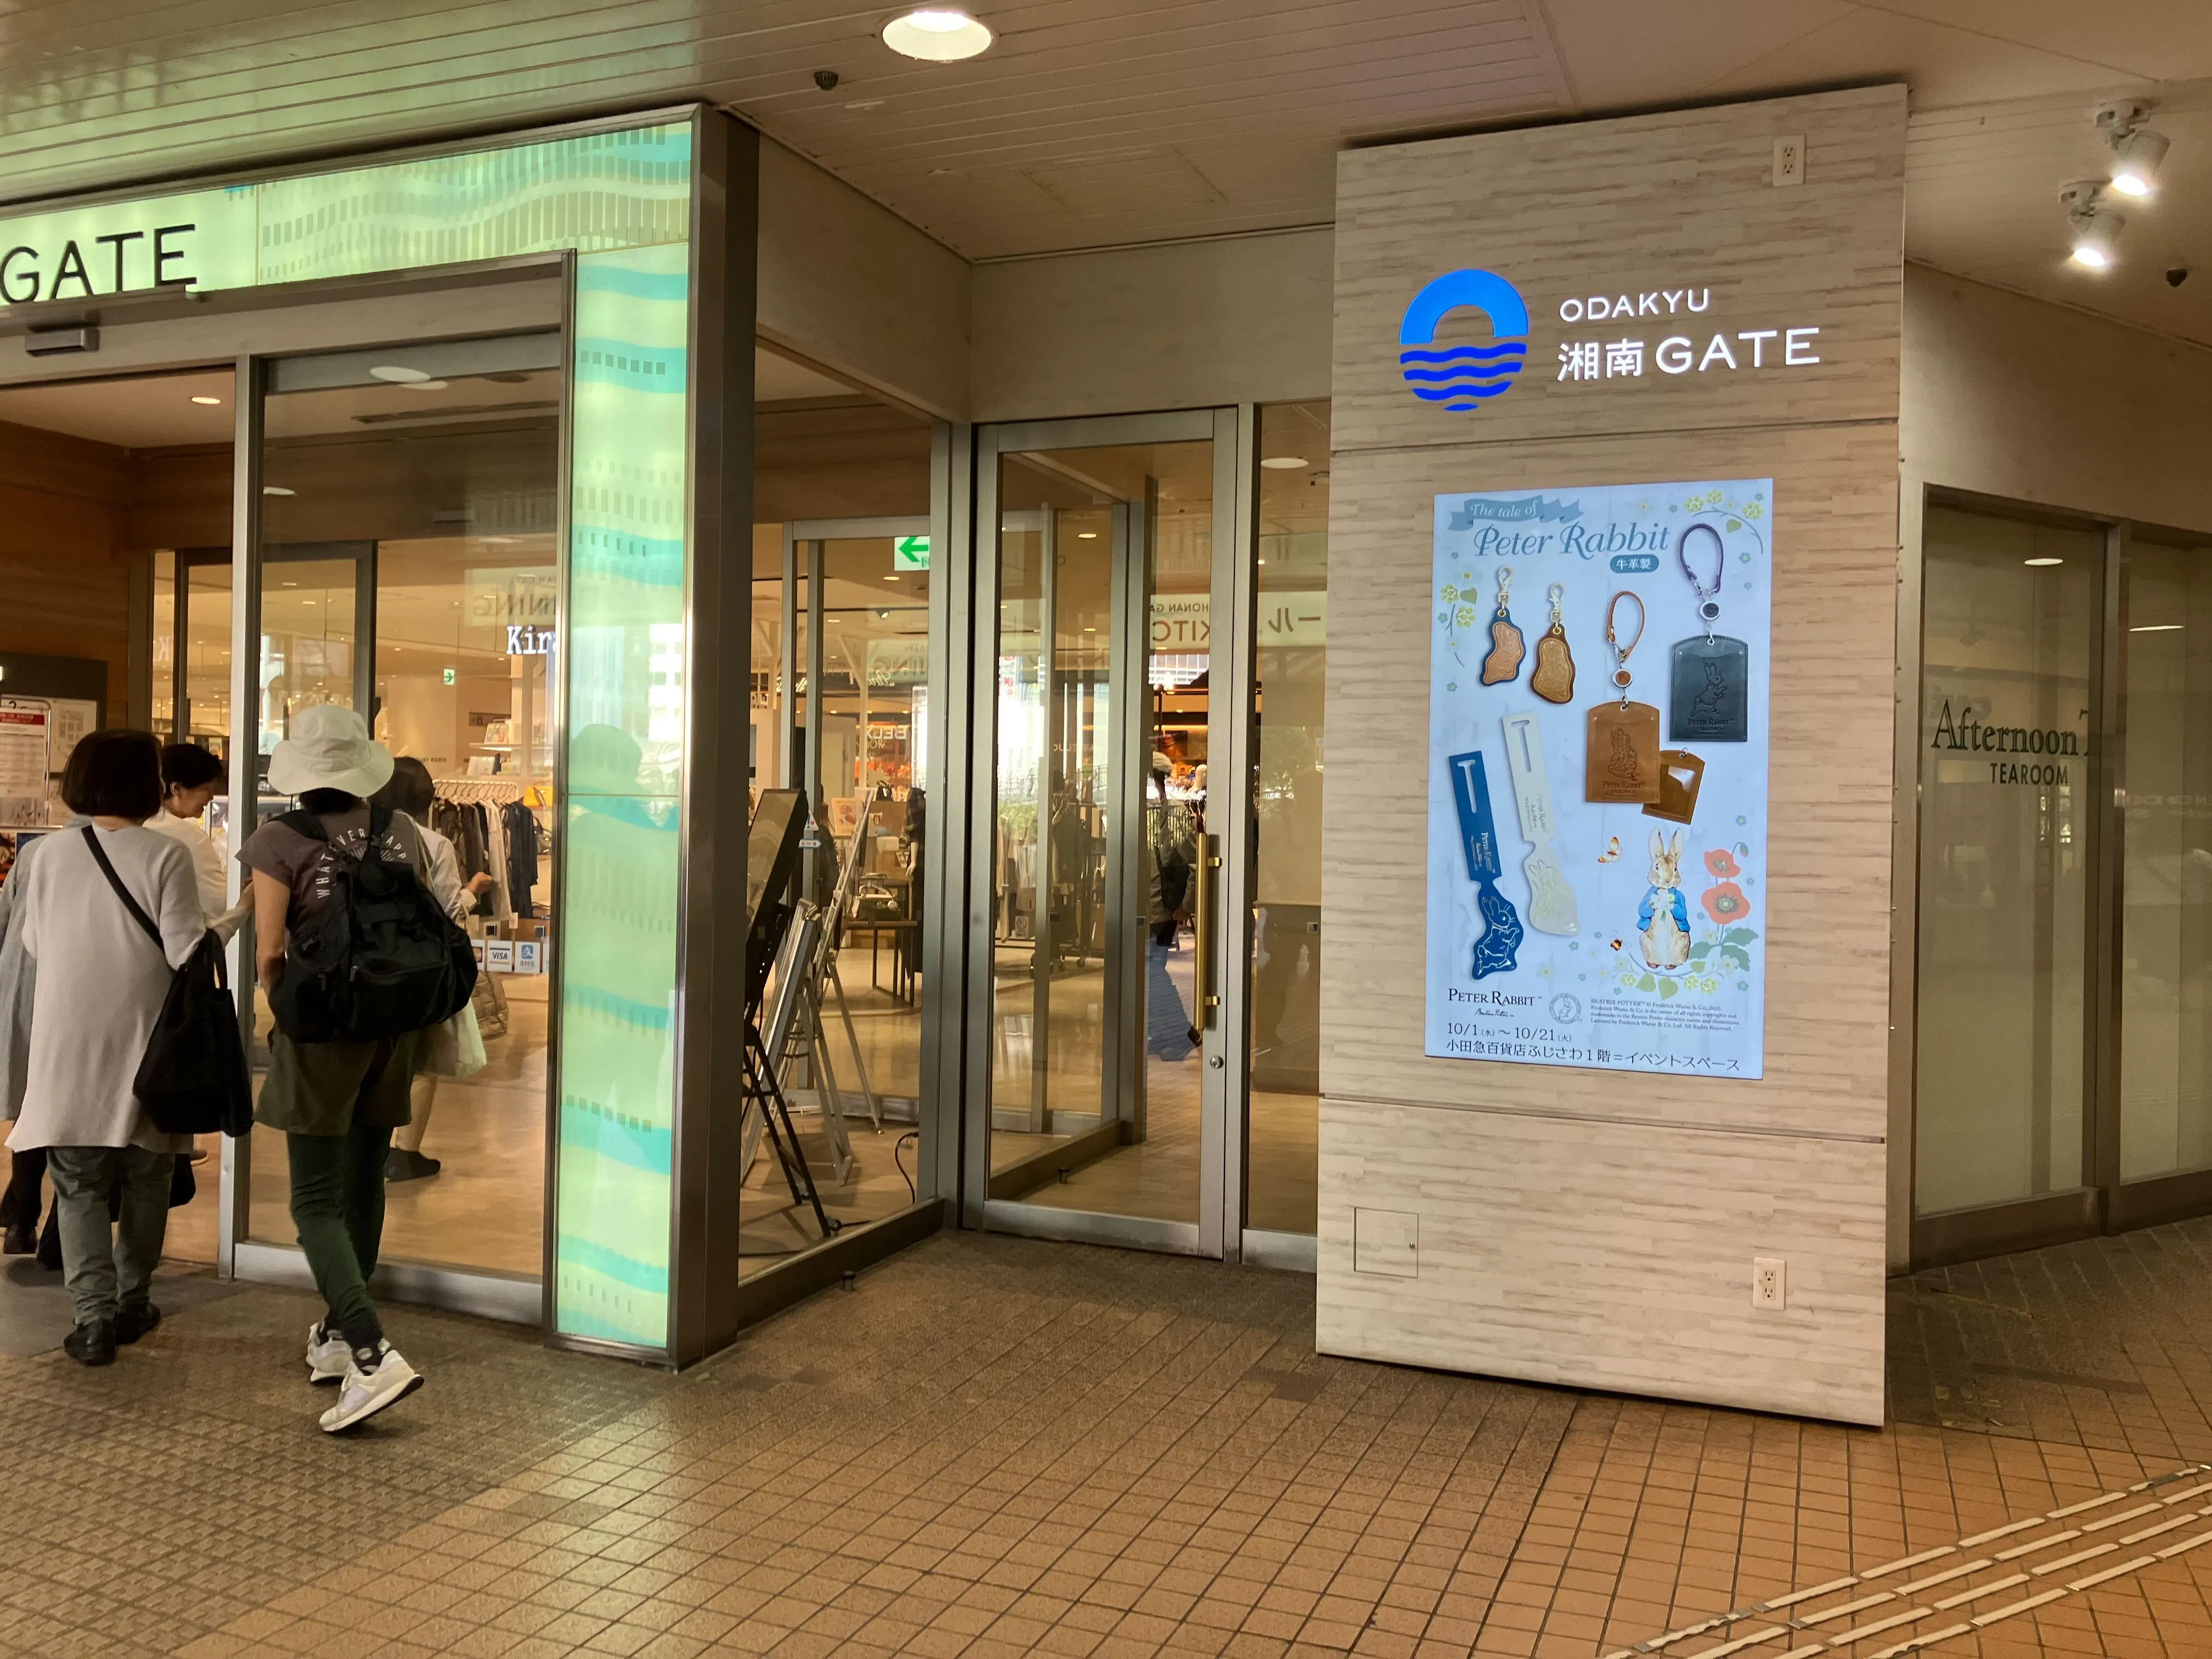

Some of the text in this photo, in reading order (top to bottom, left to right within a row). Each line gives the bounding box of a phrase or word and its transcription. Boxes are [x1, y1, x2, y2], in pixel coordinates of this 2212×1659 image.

[0, 224, 196, 302] GATE
[1560, 289, 1708, 323] ODAKYU
[1558, 328, 1820, 381] 湘南 GATE
[1470, 500, 1537, 517] The tale of
[1474, 521, 1670, 560] Peter Rabbit
[1616, 557, 1651, 570] 牛革製
[506, 625, 556, 654] Kir
[1931, 698, 2079, 755] Afternoon
[1990, 763, 2069, 785] TEAROOM
[1448, 988, 1488, 1003] PETER
